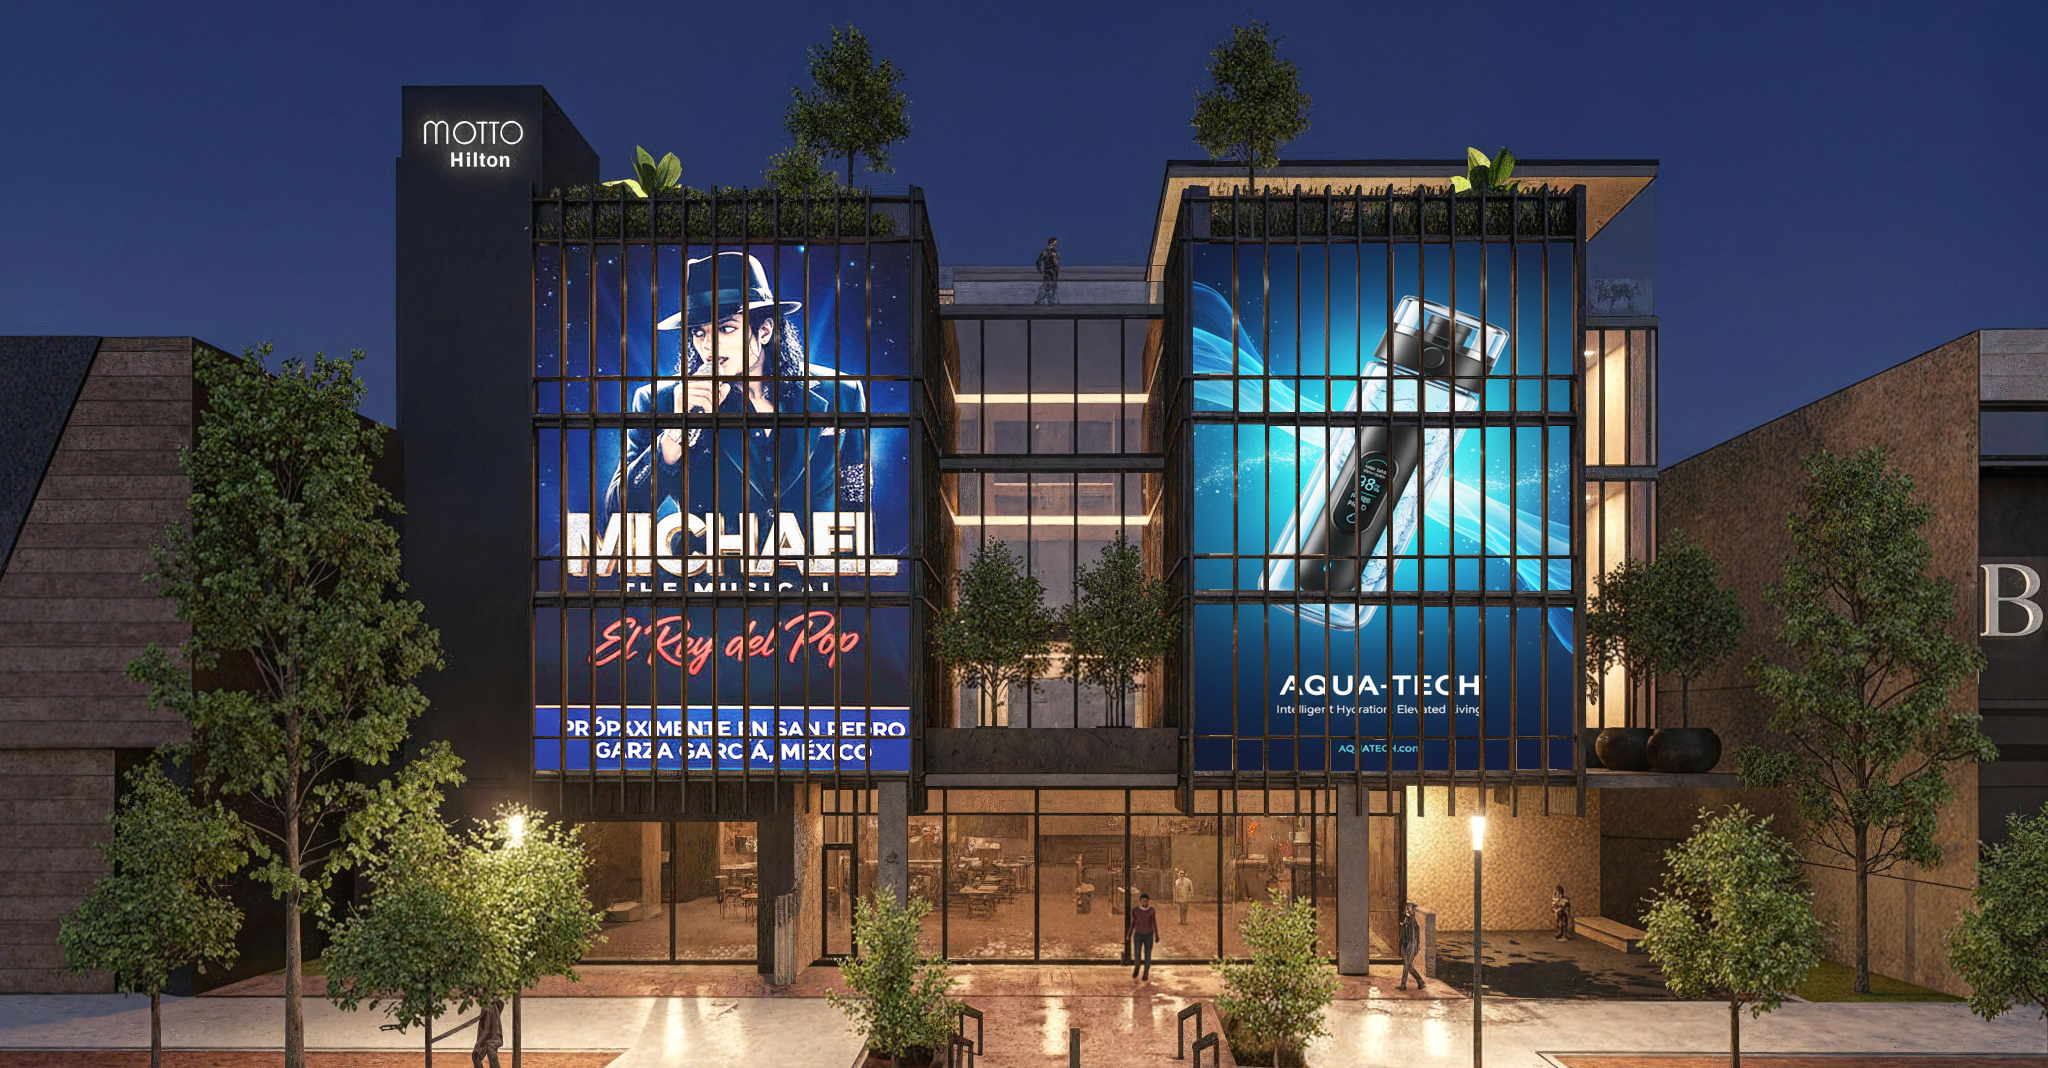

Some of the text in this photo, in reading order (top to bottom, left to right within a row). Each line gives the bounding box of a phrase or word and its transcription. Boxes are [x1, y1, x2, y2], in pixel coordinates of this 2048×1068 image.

[423, 120, 524, 145] MOTTO
[450, 151, 511, 168] Hilton
[566, 511, 899, 577] MICHAEL
[1980, 563, 2044, 637] B
[588, 610, 861, 676] El Rey del Pop
[1279, 674, 1481, 697] AQUA-TECH
[1454, 704, 1480, 717] iving
[777, 720, 820, 737] SAN
[827, 721, 906, 737] PEDRO
[595, 741, 674, 759] GARZA
[679, 739, 774, 763] GARCÁ,
[1338, 744, 1420, 754] AQATECH.com
